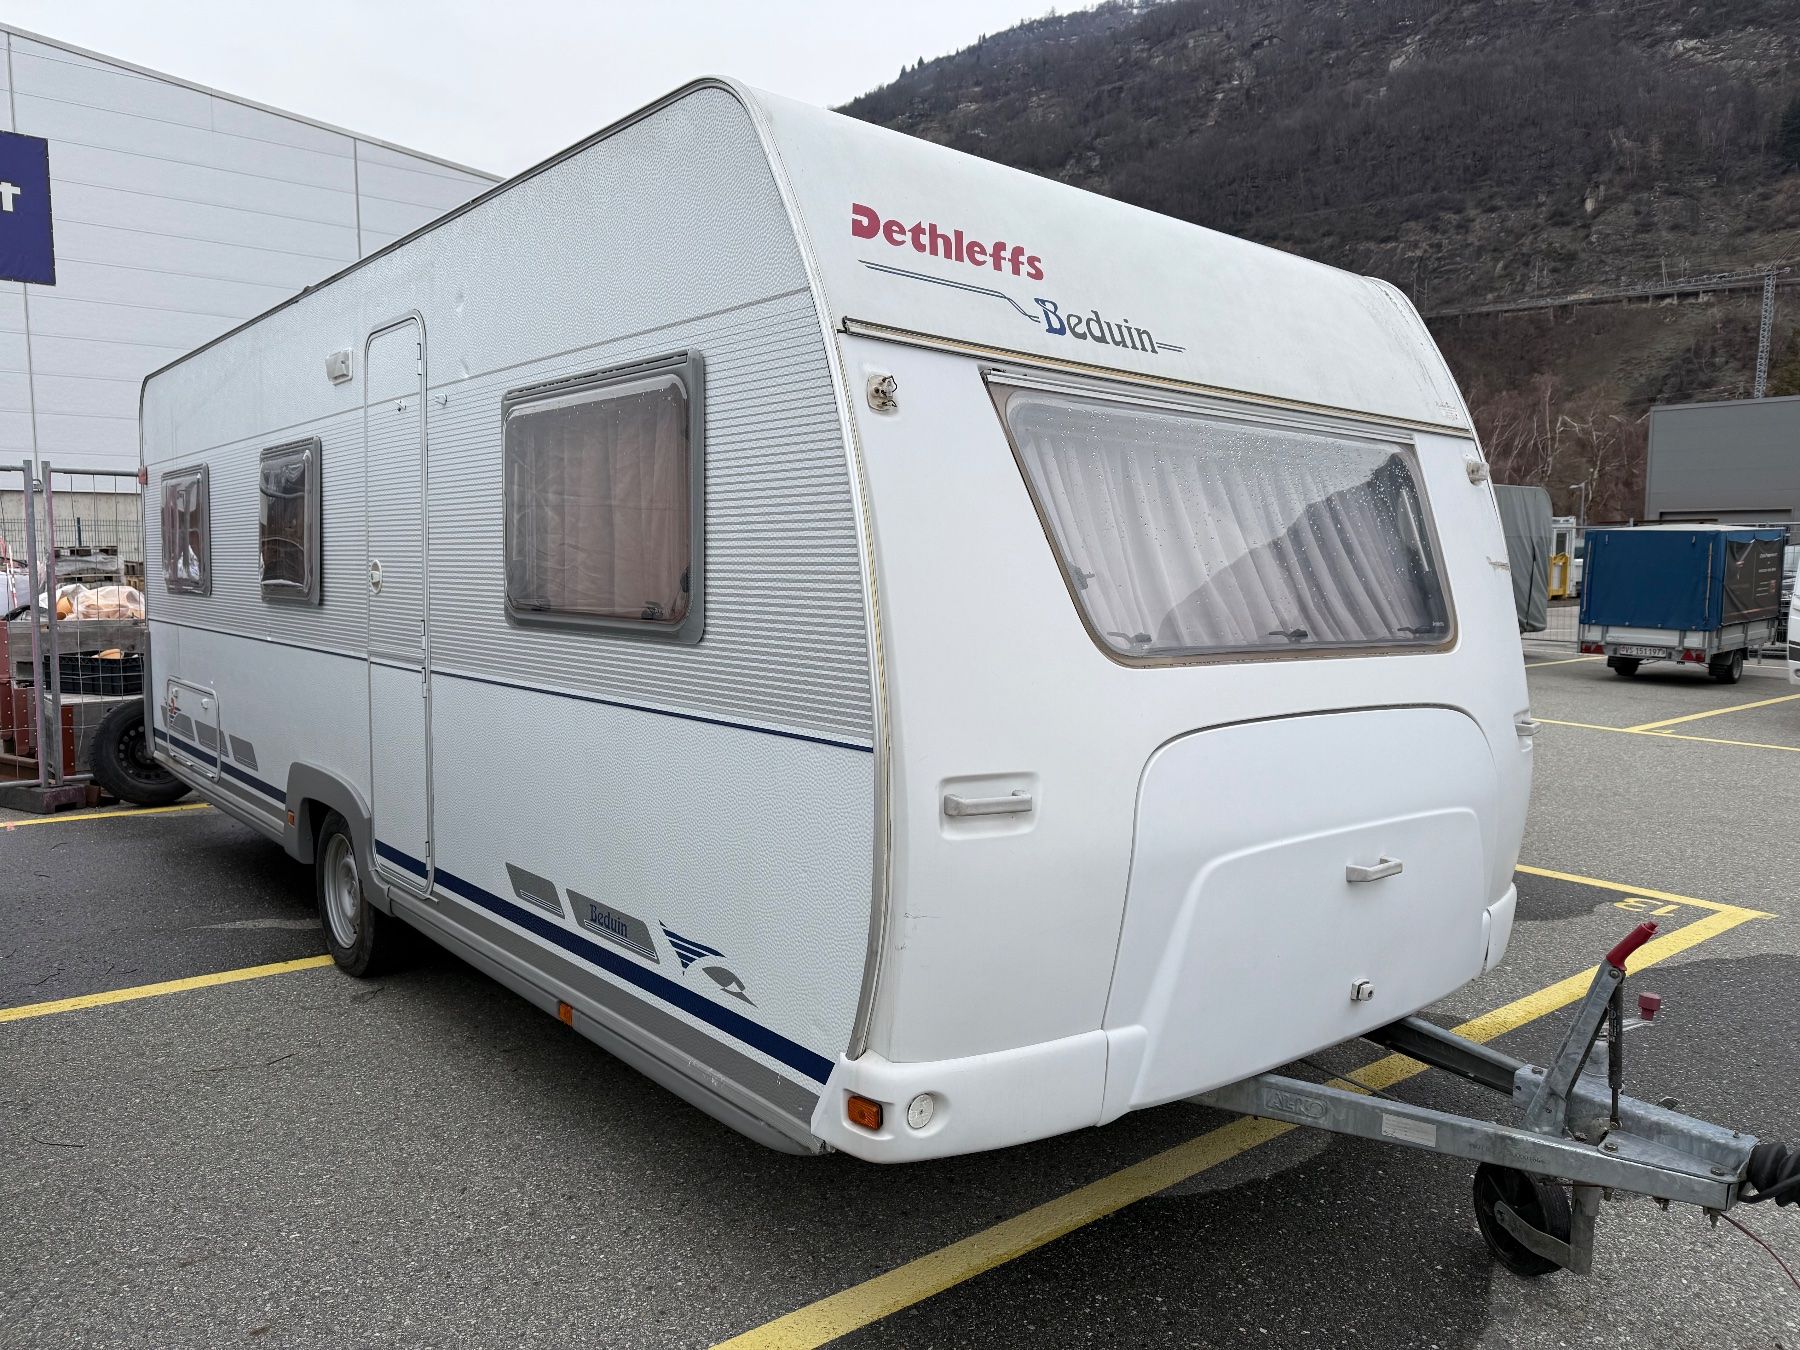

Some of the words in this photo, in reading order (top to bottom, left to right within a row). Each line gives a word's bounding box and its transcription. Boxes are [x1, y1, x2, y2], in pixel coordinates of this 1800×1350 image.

[852, 202, 1044, 281] Dethleffs
[1034, 298, 1158, 354] Beduin
[590, 904, 628, 938] Beduin
